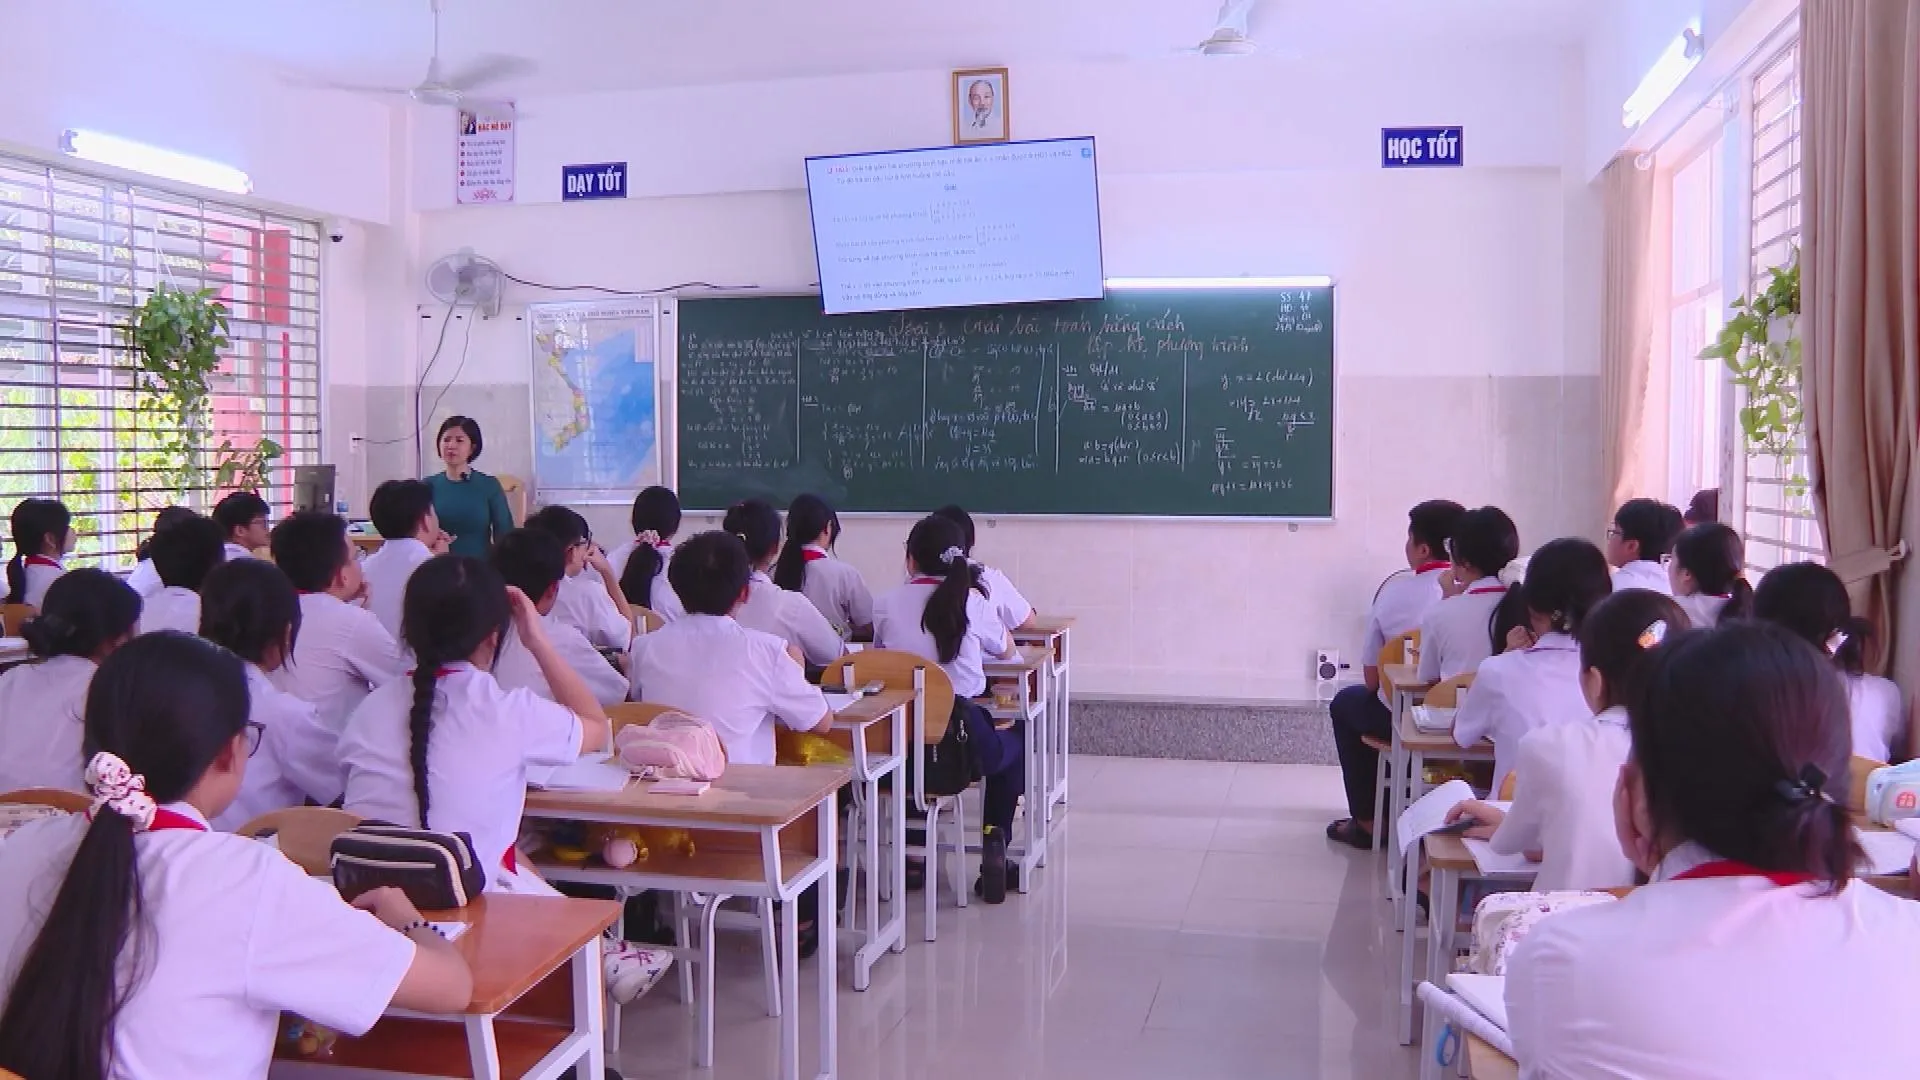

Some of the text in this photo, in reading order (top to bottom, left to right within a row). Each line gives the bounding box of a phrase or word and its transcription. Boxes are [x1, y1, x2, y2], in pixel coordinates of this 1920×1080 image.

[1387, 129, 1459, 164] HỌC TỐT
[567, 165, 622, 197] DẠY TỐT
